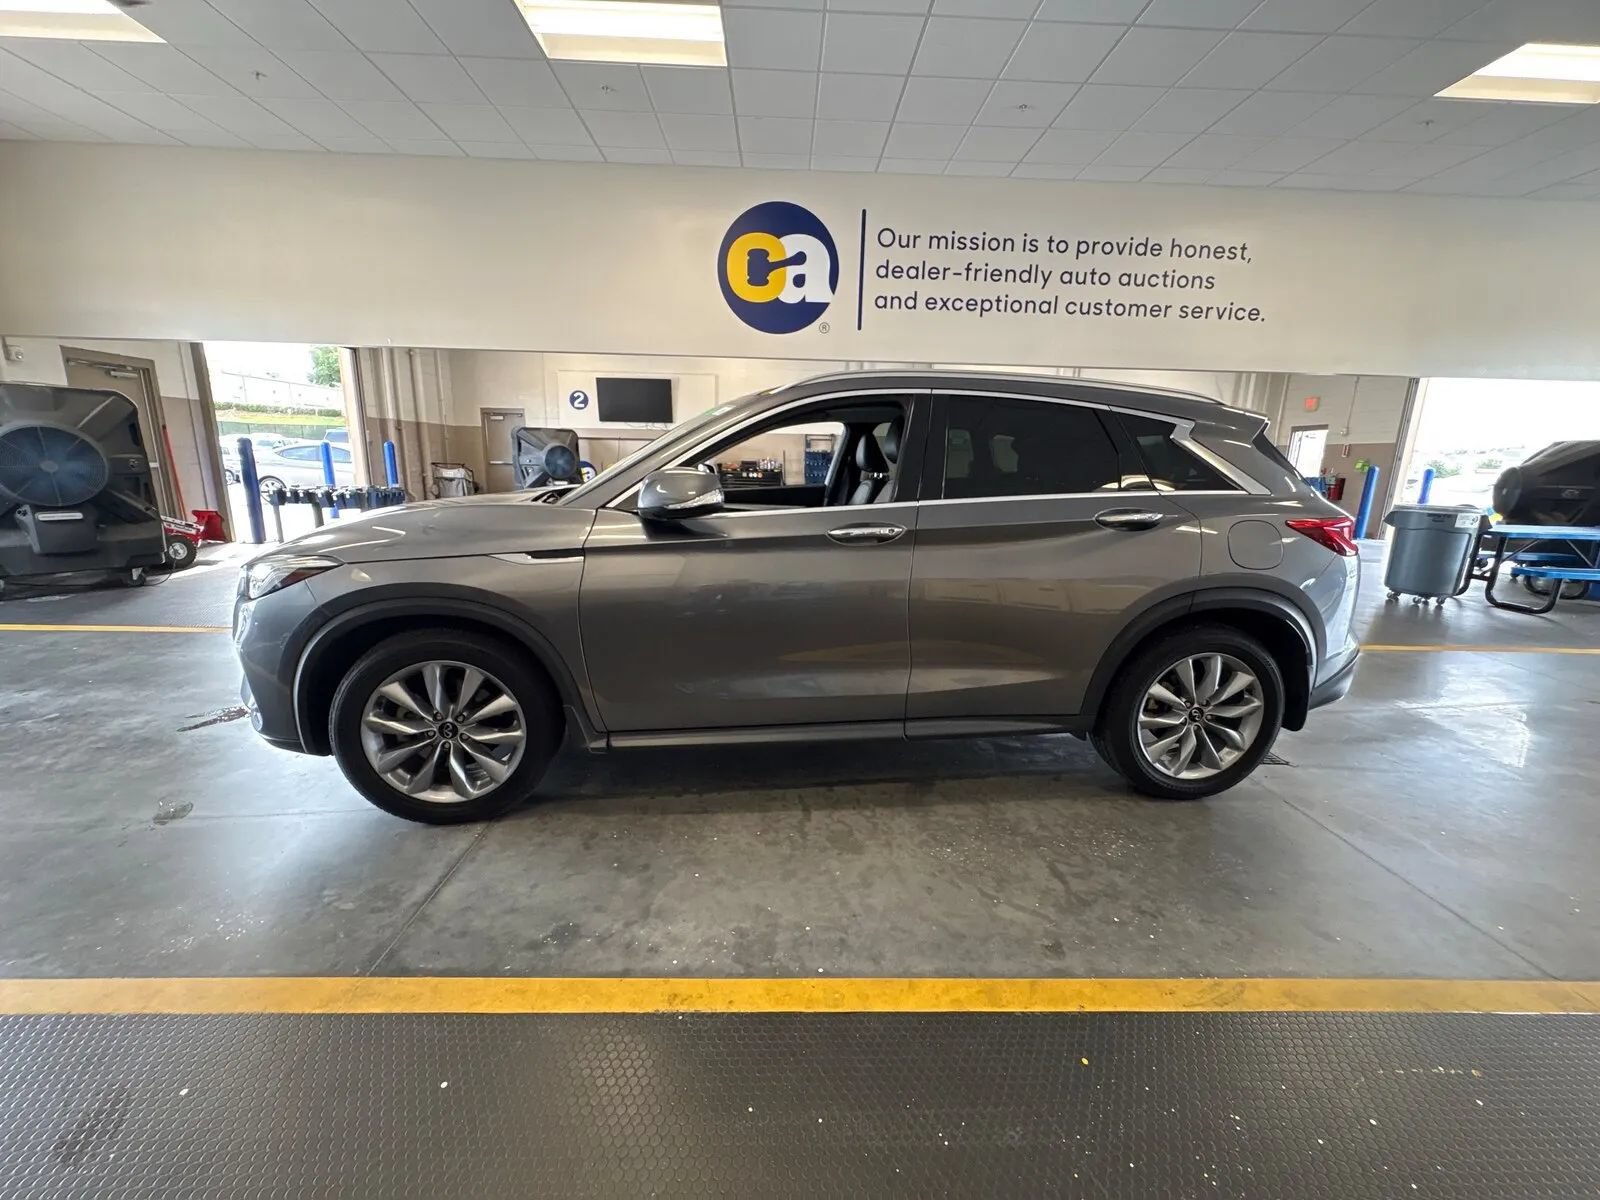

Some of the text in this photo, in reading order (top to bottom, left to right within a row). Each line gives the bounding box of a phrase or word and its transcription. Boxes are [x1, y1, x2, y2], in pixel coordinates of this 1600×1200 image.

[877, 227, 1252, 264] Our mission is to provide honest,
[875, 258, 1216, 290] dealer-friendly auto auctions
[874, 290, 1266, 322] and exceptional customer service.
[573, 392, 585, 408] 2
